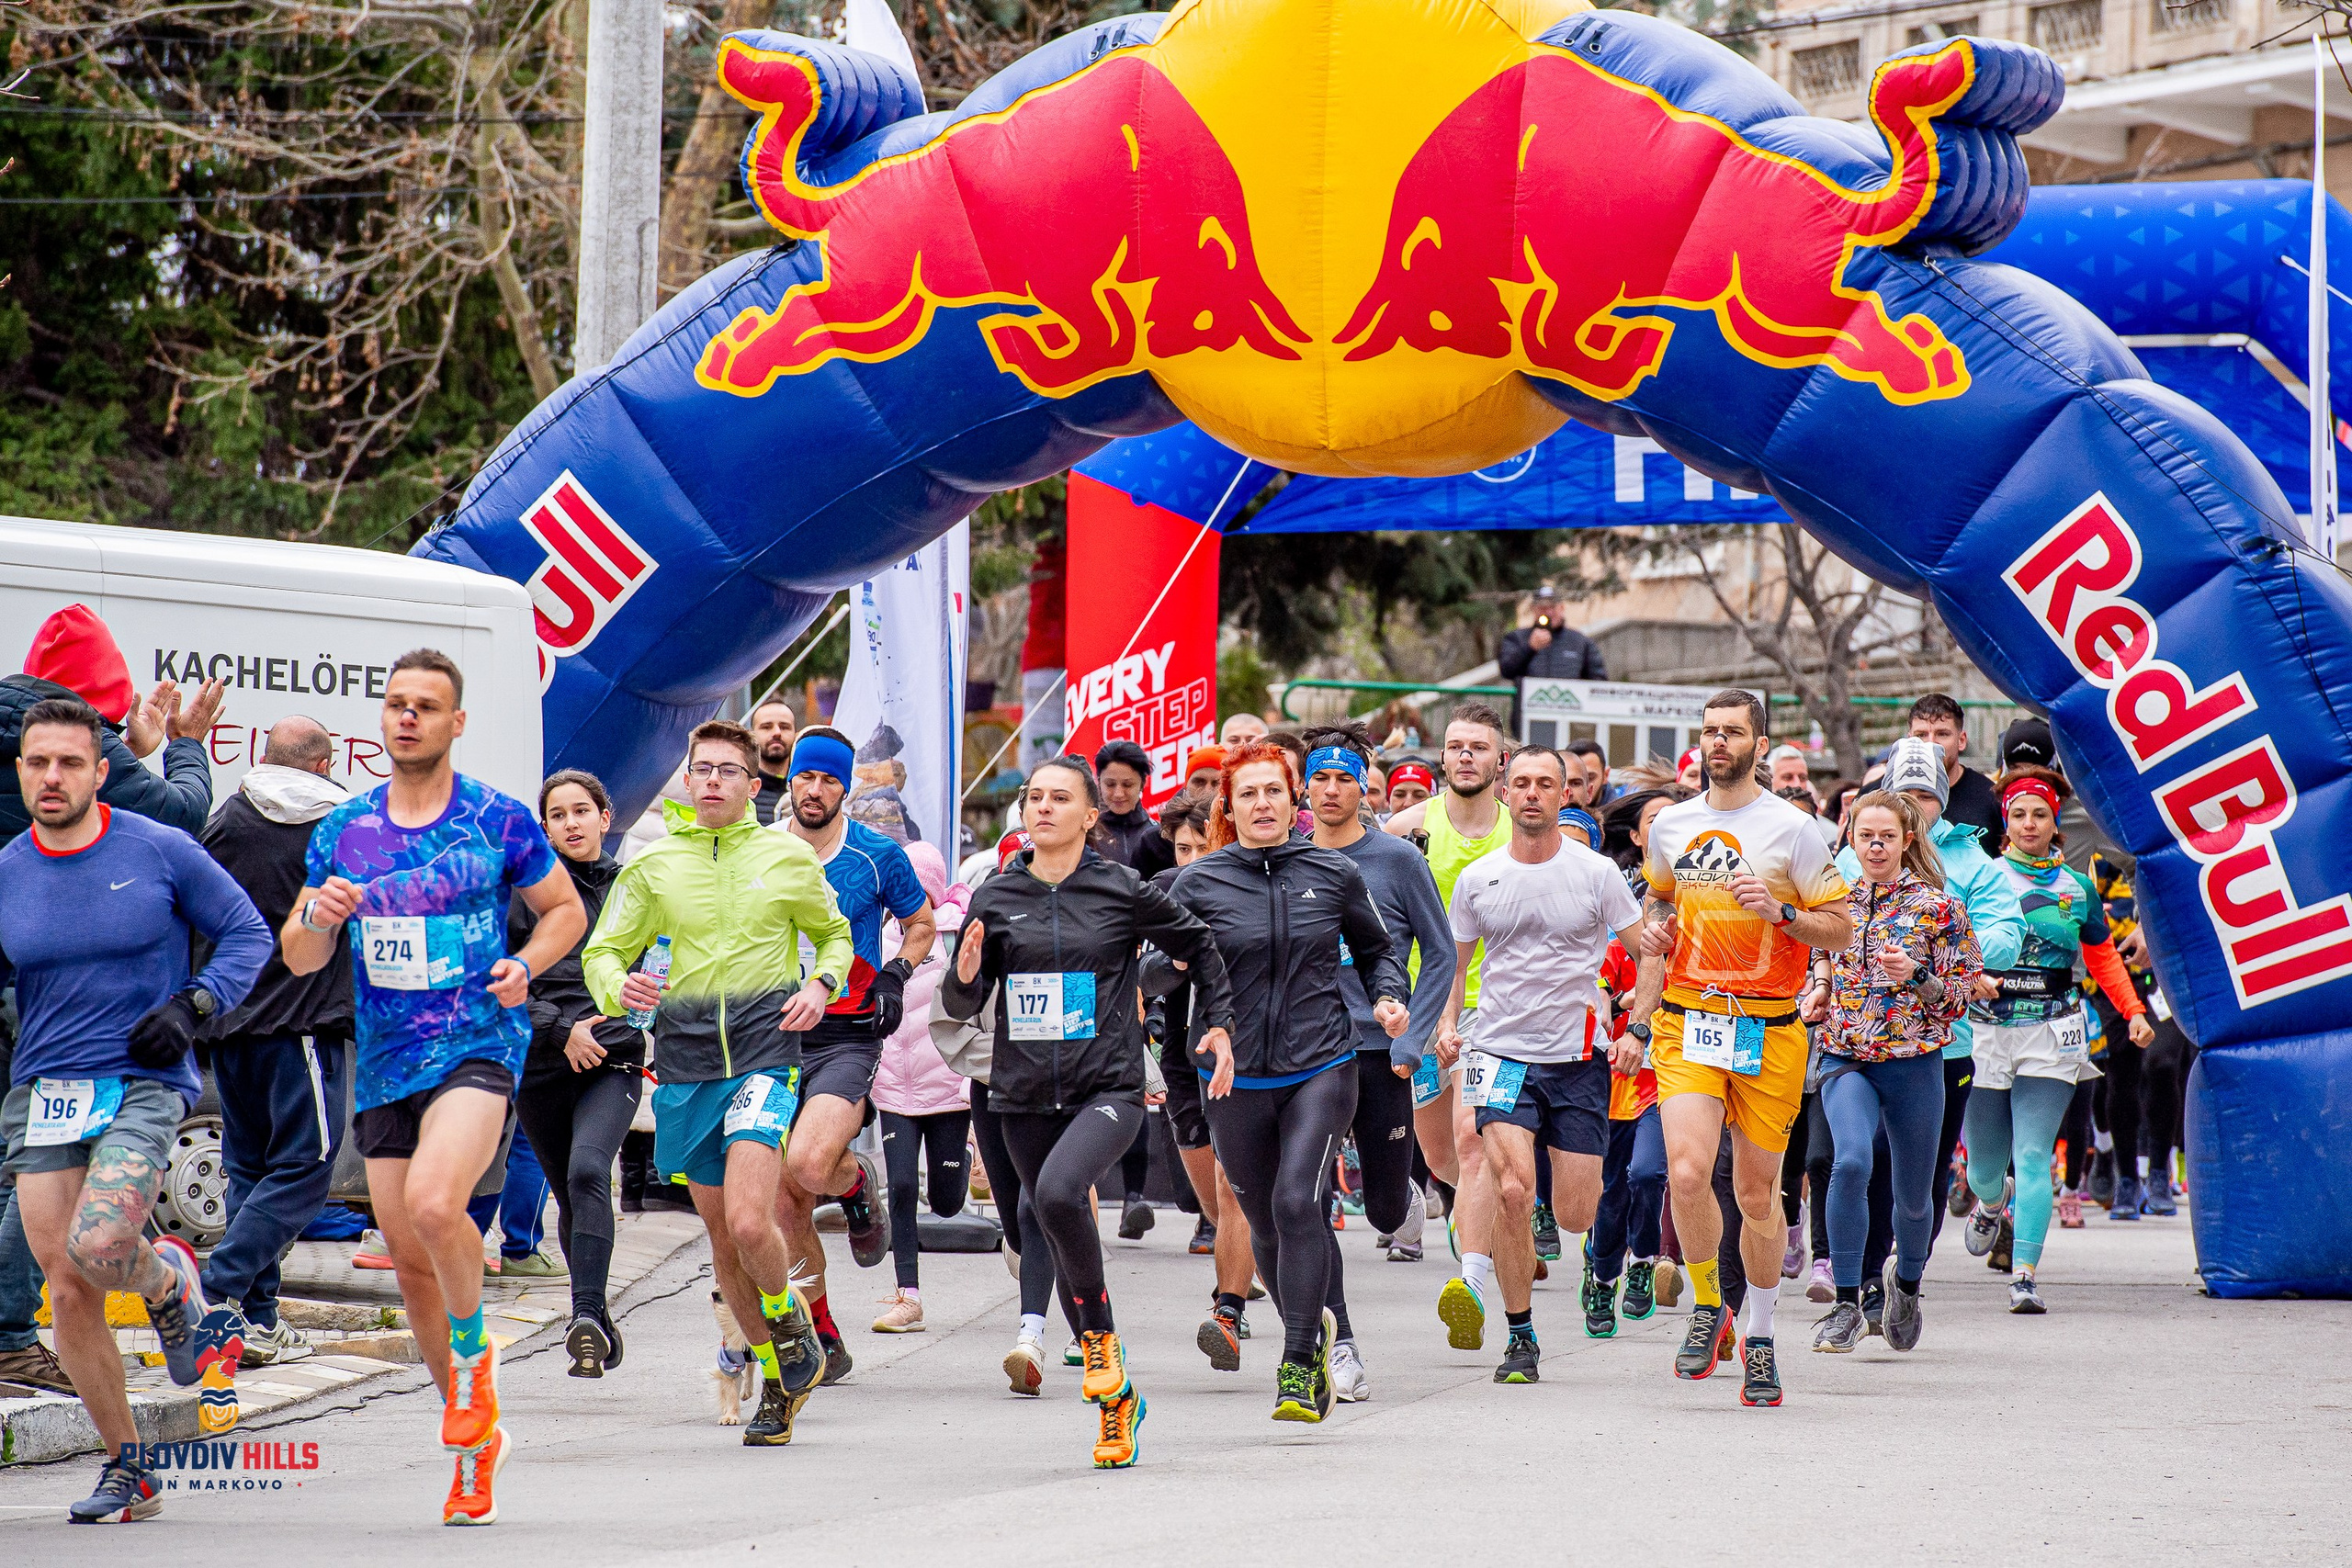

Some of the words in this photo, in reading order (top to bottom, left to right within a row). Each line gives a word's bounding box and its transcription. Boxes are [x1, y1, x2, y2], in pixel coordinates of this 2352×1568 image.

[533, 481, 648, 682] ull
[154, 648, 396, 701] KACHELÖFE
[1102, 676, 1208, 750] STEP
[2009, 499, 2249, 764] Red
[2159, 742, 2352, 998] Bull
[1680, 882, 1710, 891] SKY
[373, 940, 413, 962] 274
[1017, 993, 1048, 1015] 177
[1694, 1028, 1723, 1047] 165
[2062, 1029, 2082, 1046] 223
[1466, 1067, 1485, 1085] 105
[43, 1098, 77, 1120] 196
